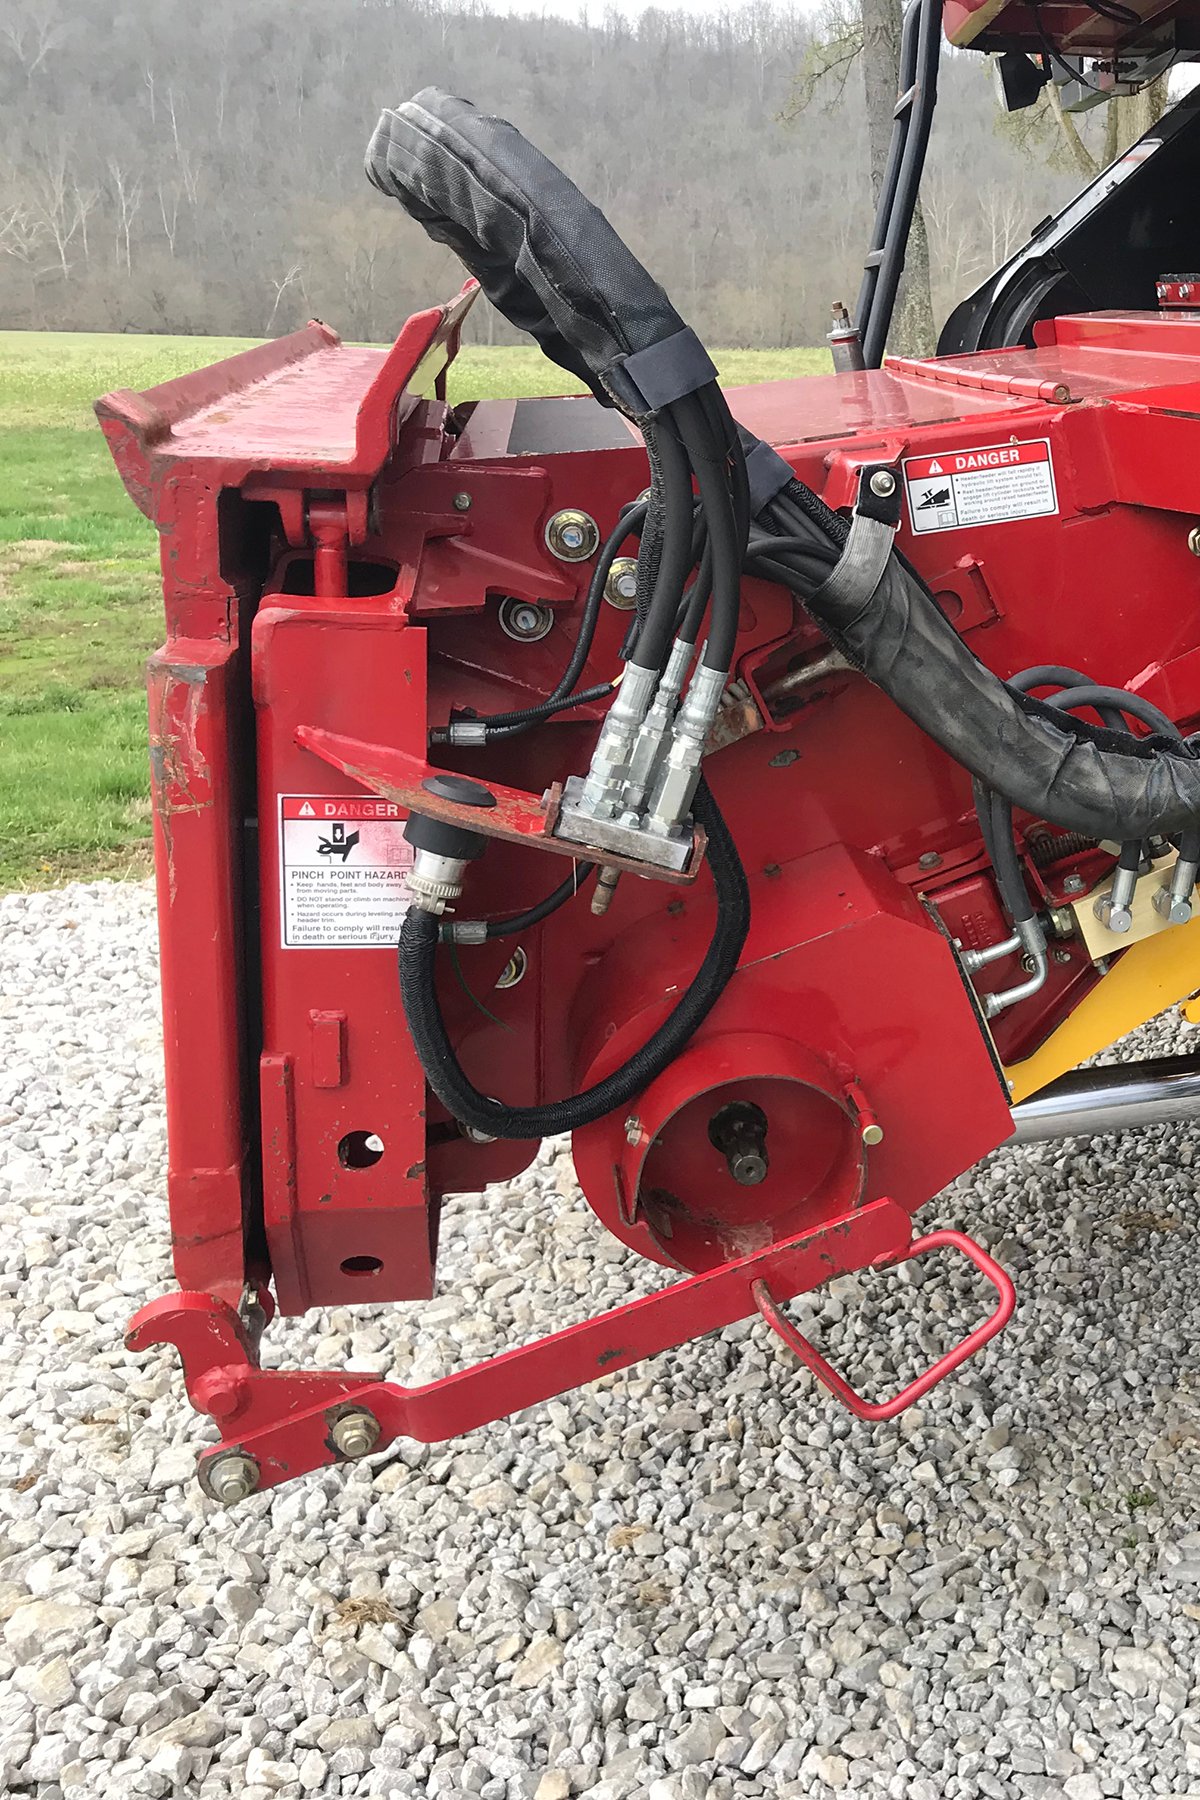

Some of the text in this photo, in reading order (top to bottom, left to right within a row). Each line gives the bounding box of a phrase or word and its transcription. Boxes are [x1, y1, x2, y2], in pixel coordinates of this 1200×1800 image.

[955, 449, 1020, 470] DANGER
[976, 484, 1011, 492] header/feeder
[324, 803, 398, 816] DANGER
[291, 870, 408, 880] PINCH POINT HAZARD
[333, 925, 364, 933] comply
[365, 924, 380, 932] will
